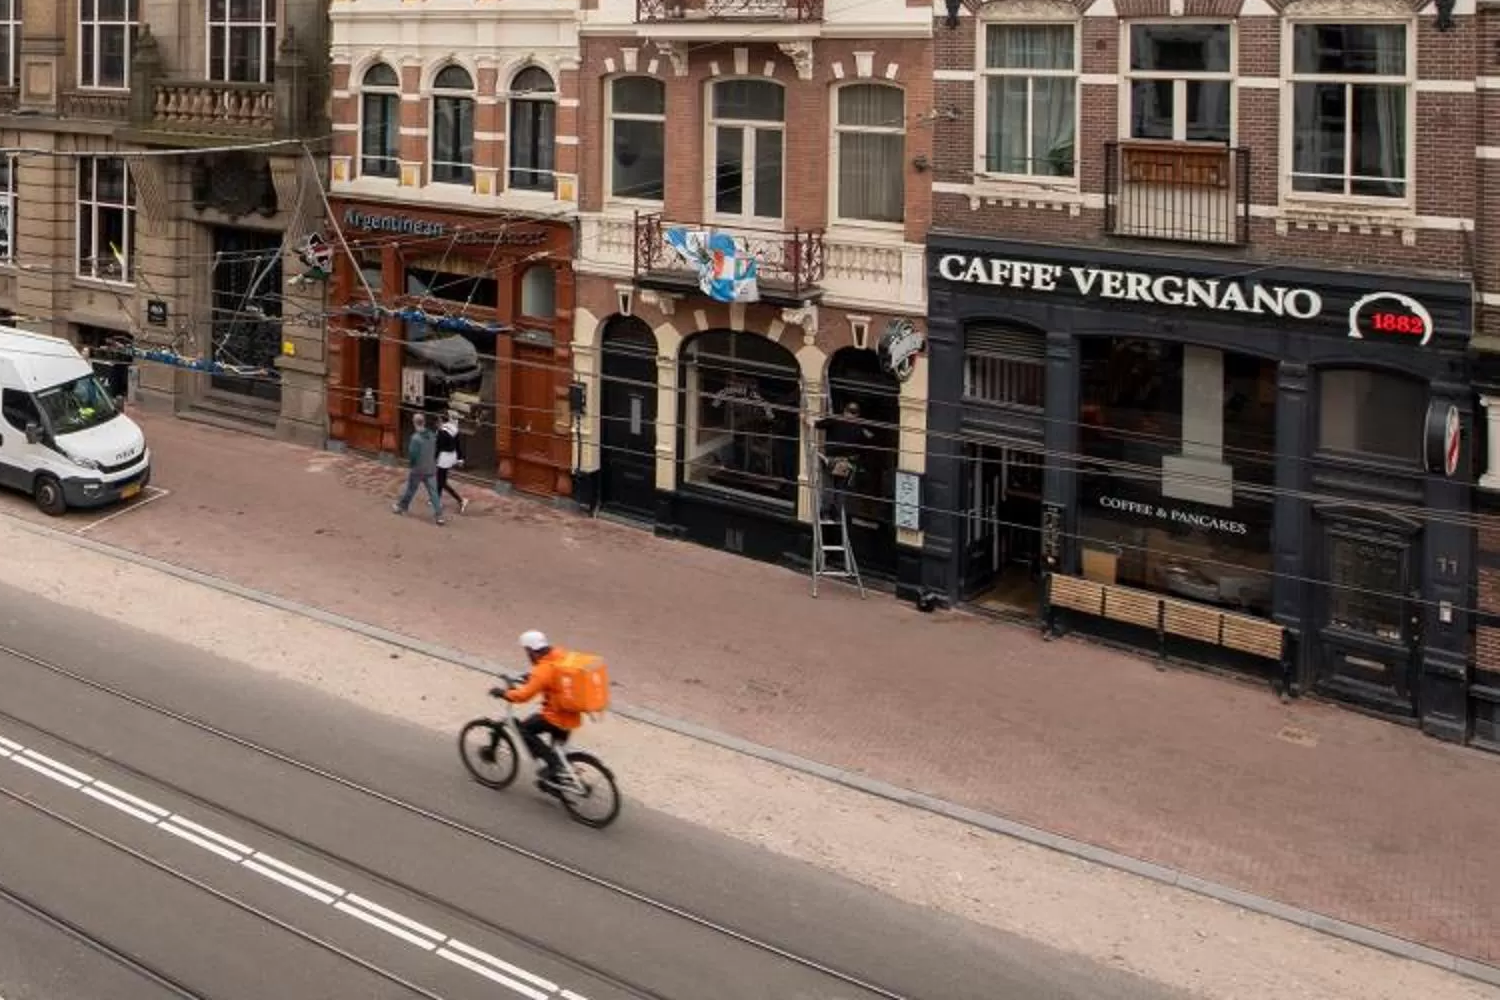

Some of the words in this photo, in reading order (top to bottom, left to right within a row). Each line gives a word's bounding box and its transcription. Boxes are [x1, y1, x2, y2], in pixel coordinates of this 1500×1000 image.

[344, 207, 444, 239] Argentinean
[1069, 266, 1323, 319] VERGNANO
[1372, 312, 1425, 334] 1882
[1100, 496, 1153, 517] COFFEE
[1156, 507, 1168, 520] &
[1171, 509, 1247, 536] PANCAKES
